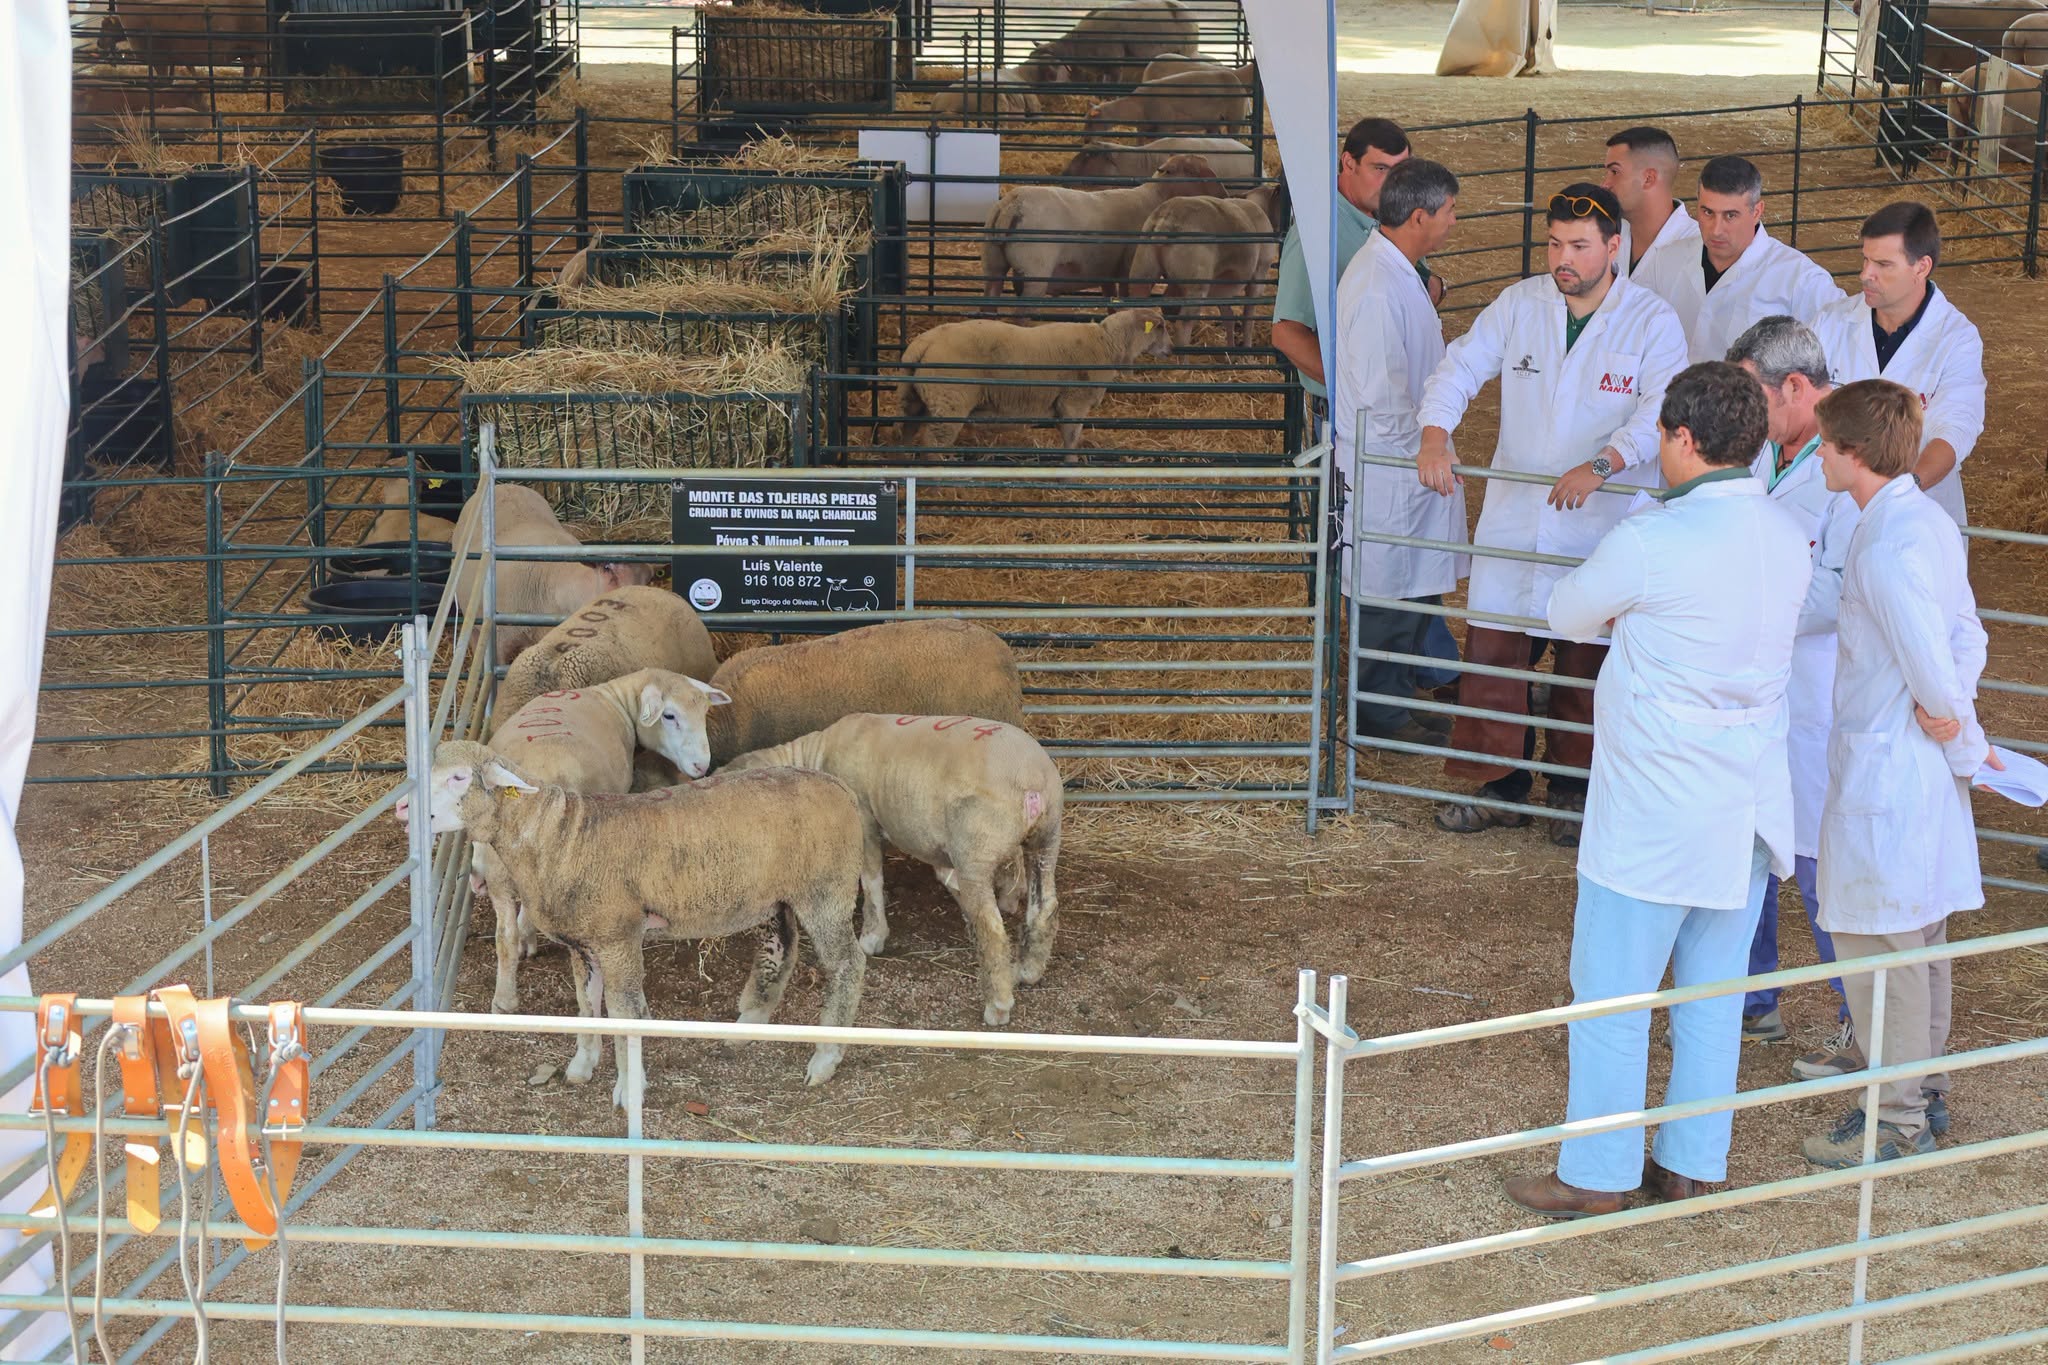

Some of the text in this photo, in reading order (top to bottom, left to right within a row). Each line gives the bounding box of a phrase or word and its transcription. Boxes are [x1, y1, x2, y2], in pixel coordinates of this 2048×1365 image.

[1599, 384, 1633, 395] NANTA
[688, 490, 877, 506] MONTE DAS TOJEIRAS PRETAS
[688, 507, 877, 522] CRIADOR DE OVINOS DA RAÇA CHAROLLAIS
[774, 560, 823, 572] Valente
[744, 574, 821, 588] 916 108 872
[741, 597, 760, 606] Largo
[762, 598, 781, 606] Diogo
